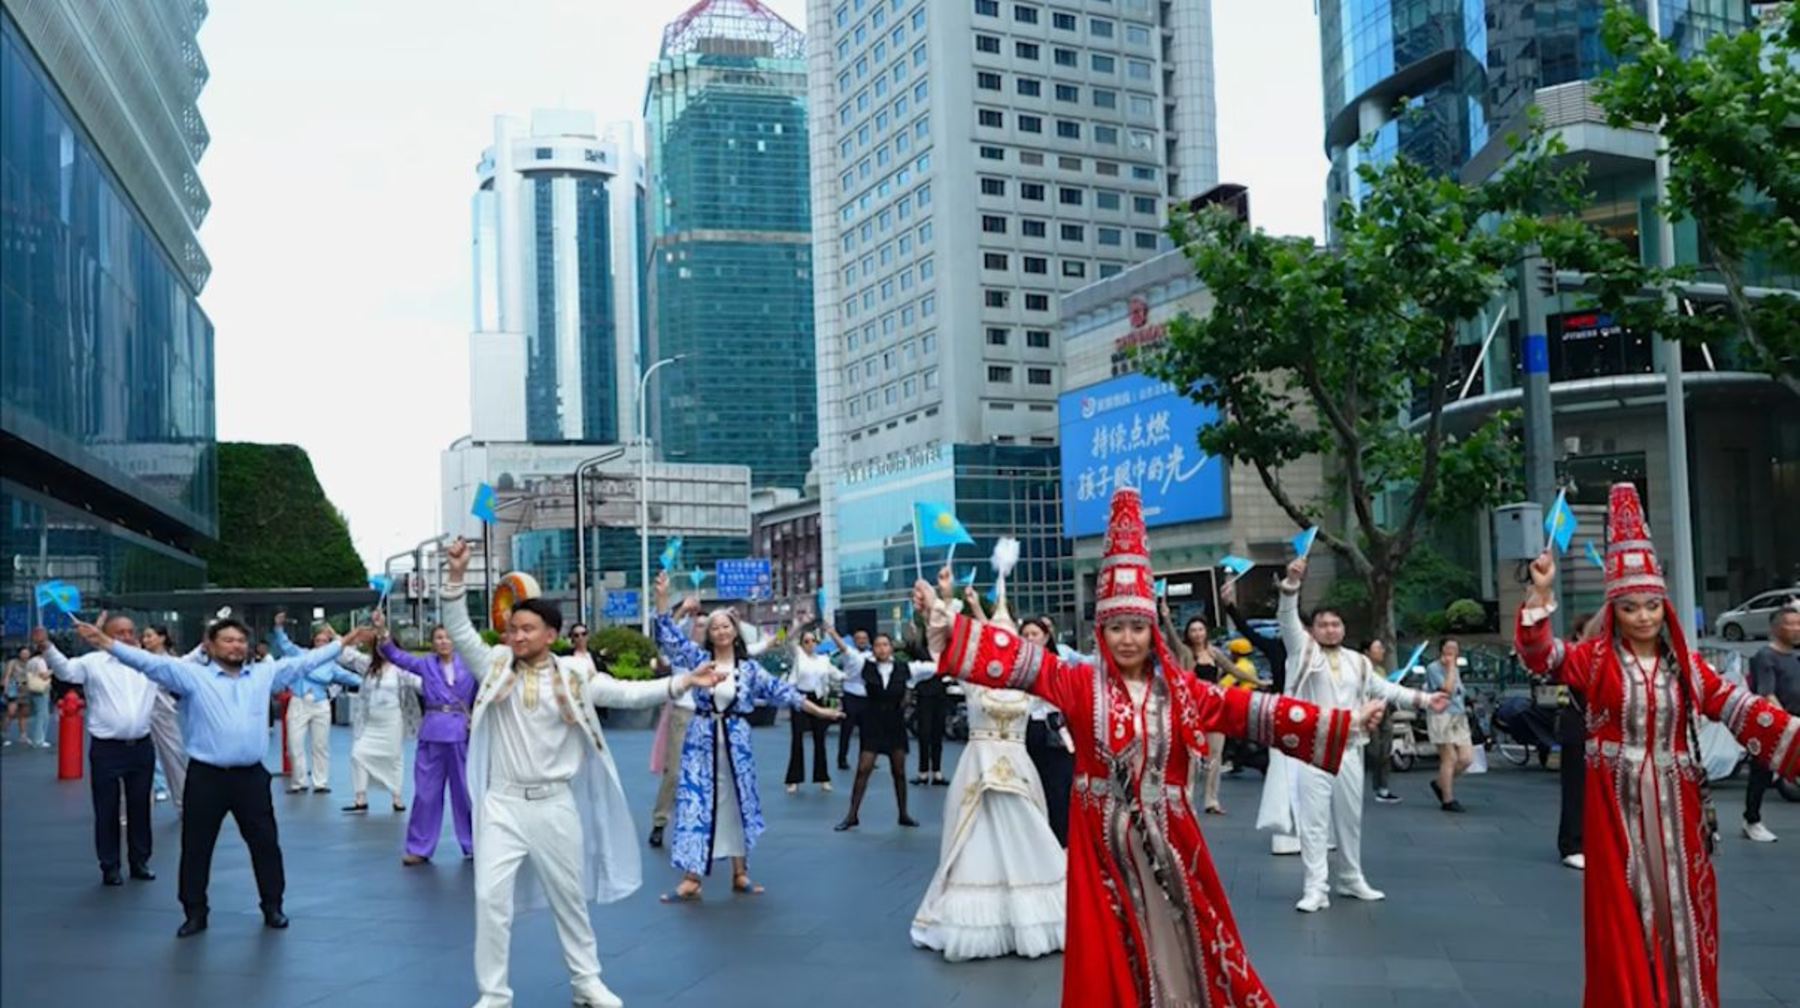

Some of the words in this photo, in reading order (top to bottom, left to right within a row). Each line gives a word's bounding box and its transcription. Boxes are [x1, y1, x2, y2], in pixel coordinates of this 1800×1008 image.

[1091, 410, 1170, 459] 持续点燃
[1077, 444, 1208, 501] 孩子眼中的光
